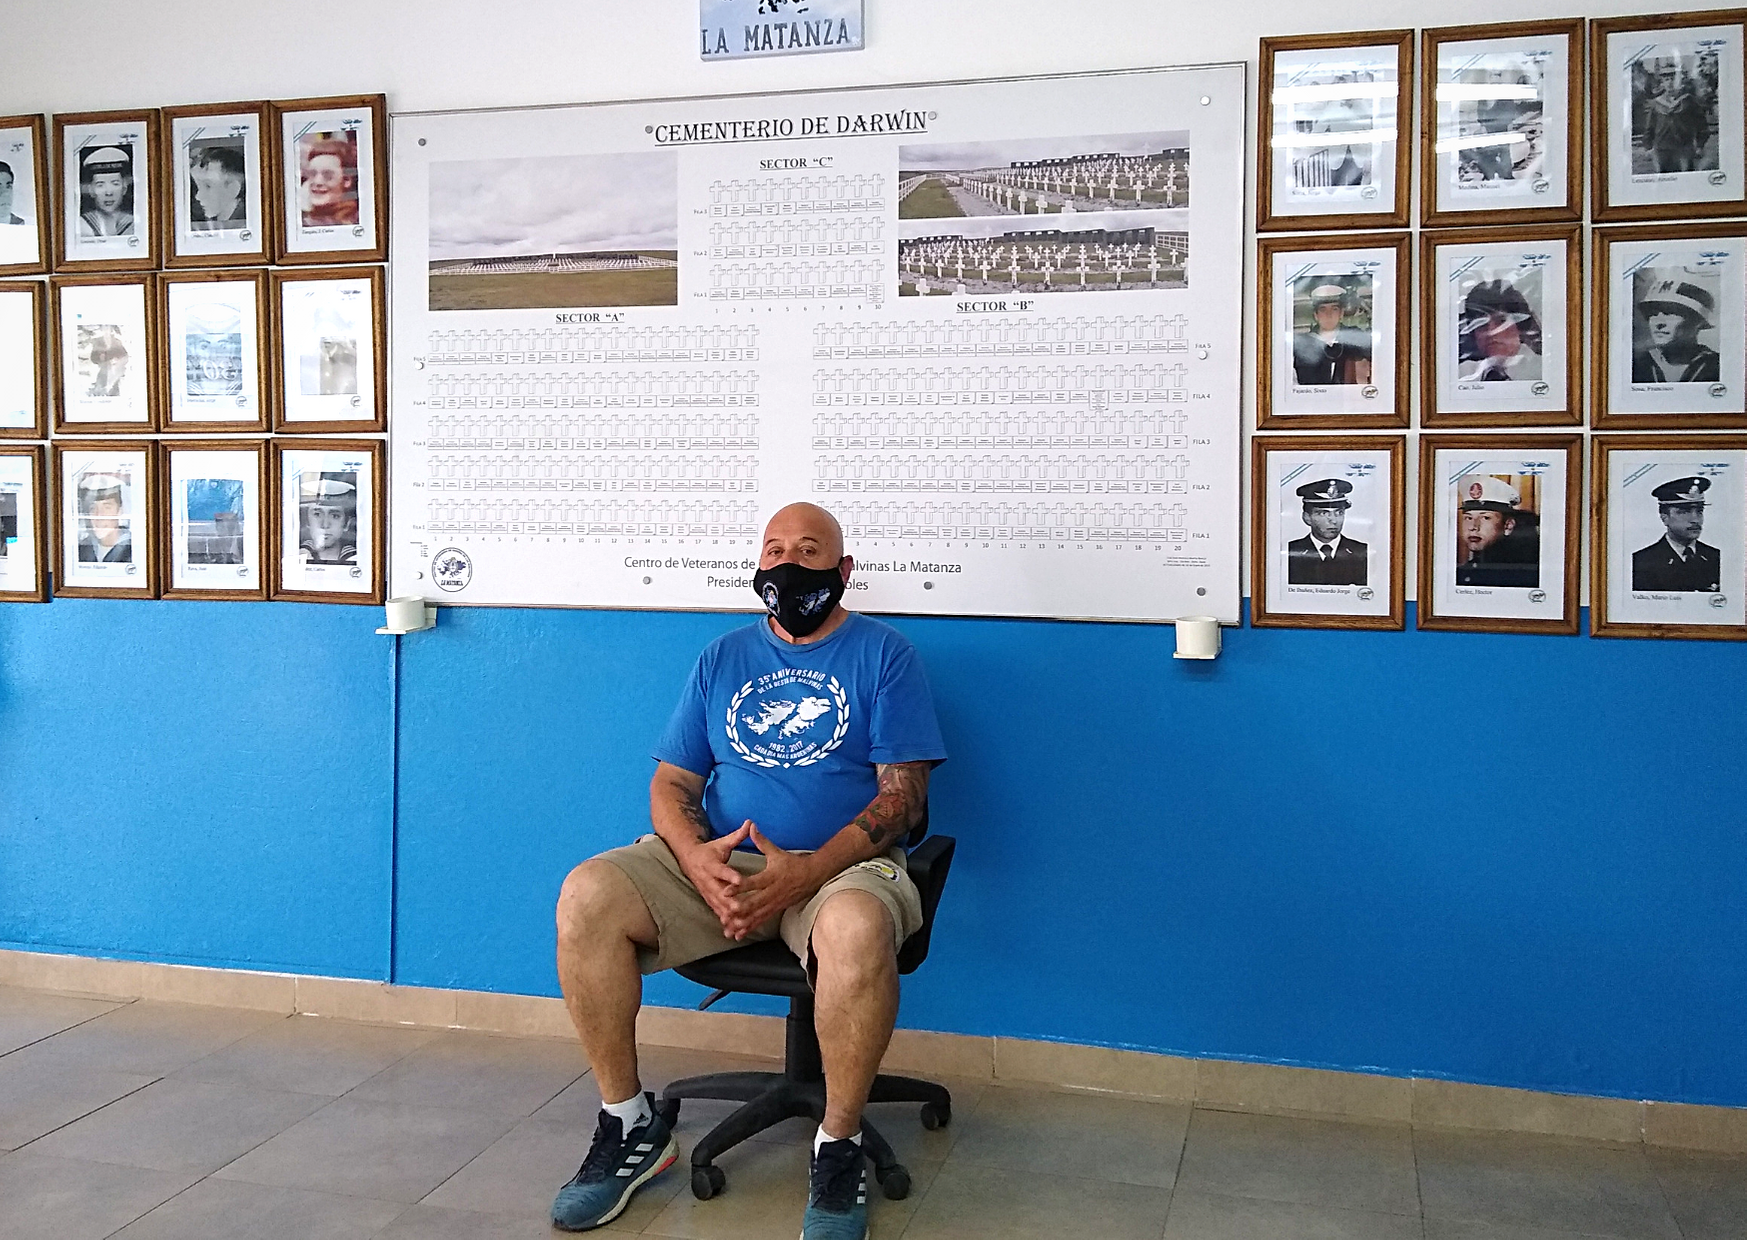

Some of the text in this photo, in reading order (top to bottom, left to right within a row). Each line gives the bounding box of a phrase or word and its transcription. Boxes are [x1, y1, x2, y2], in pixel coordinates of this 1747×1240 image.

[701, 18, 850, 55] LA MATANZA
[655, 109, 927, 142] CEMENTERIO DE DARWIN
[760, 157, 807, 169] SECTOR
[957, 301, 1008, 311] SECTOR
[556, 313, 600, 323] SECTOR
[624, 556, 961, 573] Centro de Veteranos de alvinas La Matanza
[707, 576, 869, 590] Presiden oles
[772, 668, 826, 682] ANIVERSARIO
[769, 740, 804, 753] 1982 2017
